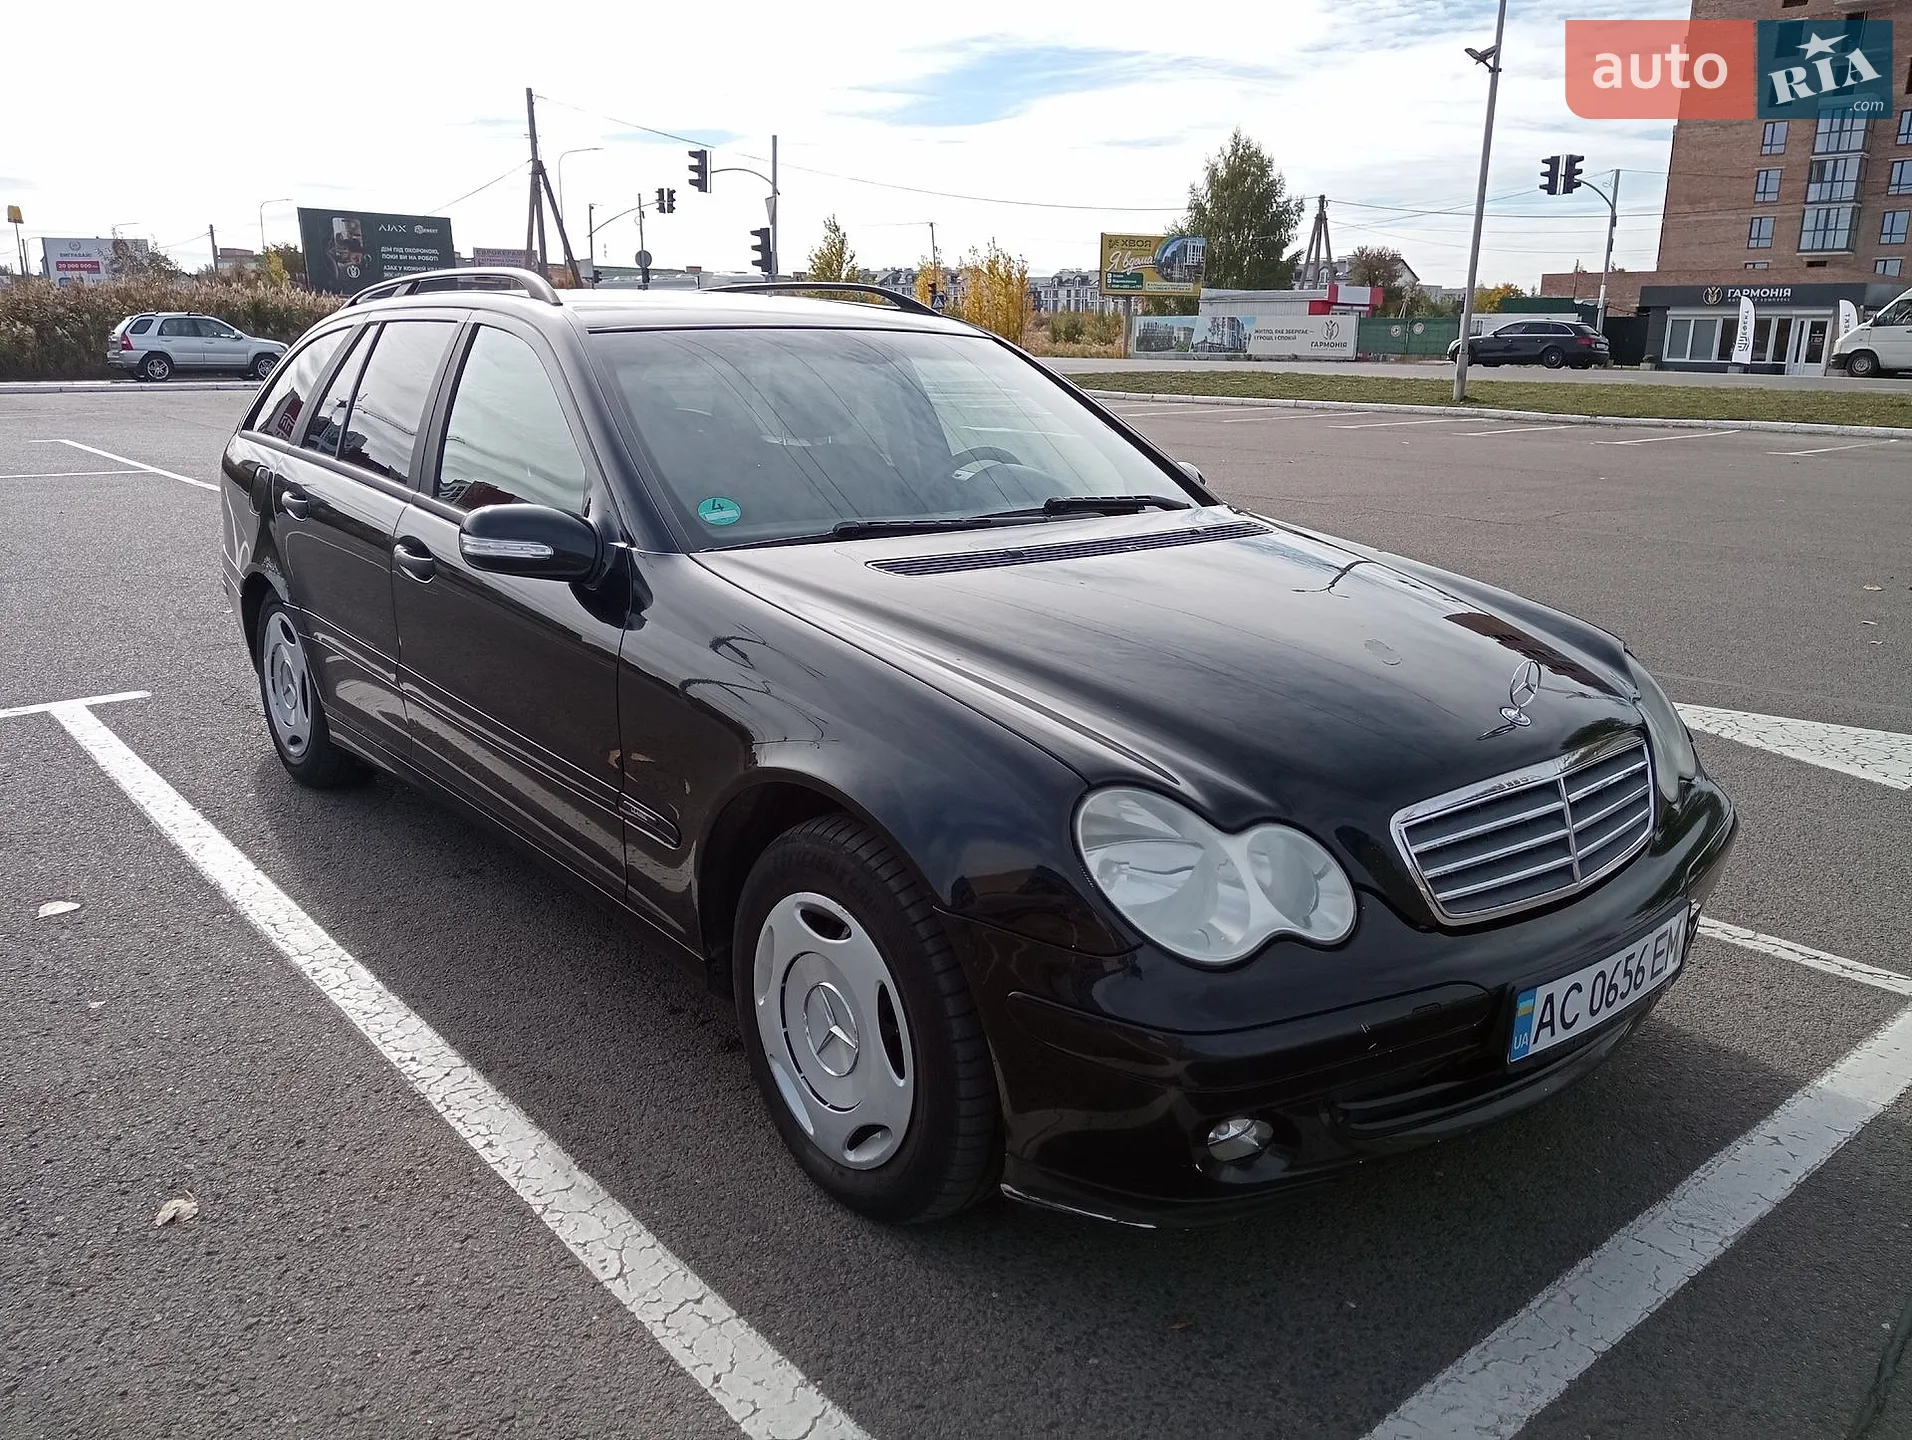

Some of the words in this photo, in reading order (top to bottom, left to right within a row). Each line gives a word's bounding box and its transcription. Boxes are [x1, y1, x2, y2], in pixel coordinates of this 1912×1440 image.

[379, 224, 406, 232] AJAX
[1120, 240, 1151, 248] ХВОЯ
[1104, 251, 1121, 271] Я
[1728, 288, 1791, 297] ГАРМОНІЯ
[1533, 982, 1583, 1045] AC
[1589, 943, 1648, 1017] 0656
[1514, 1032, 1528, 1050] UA
